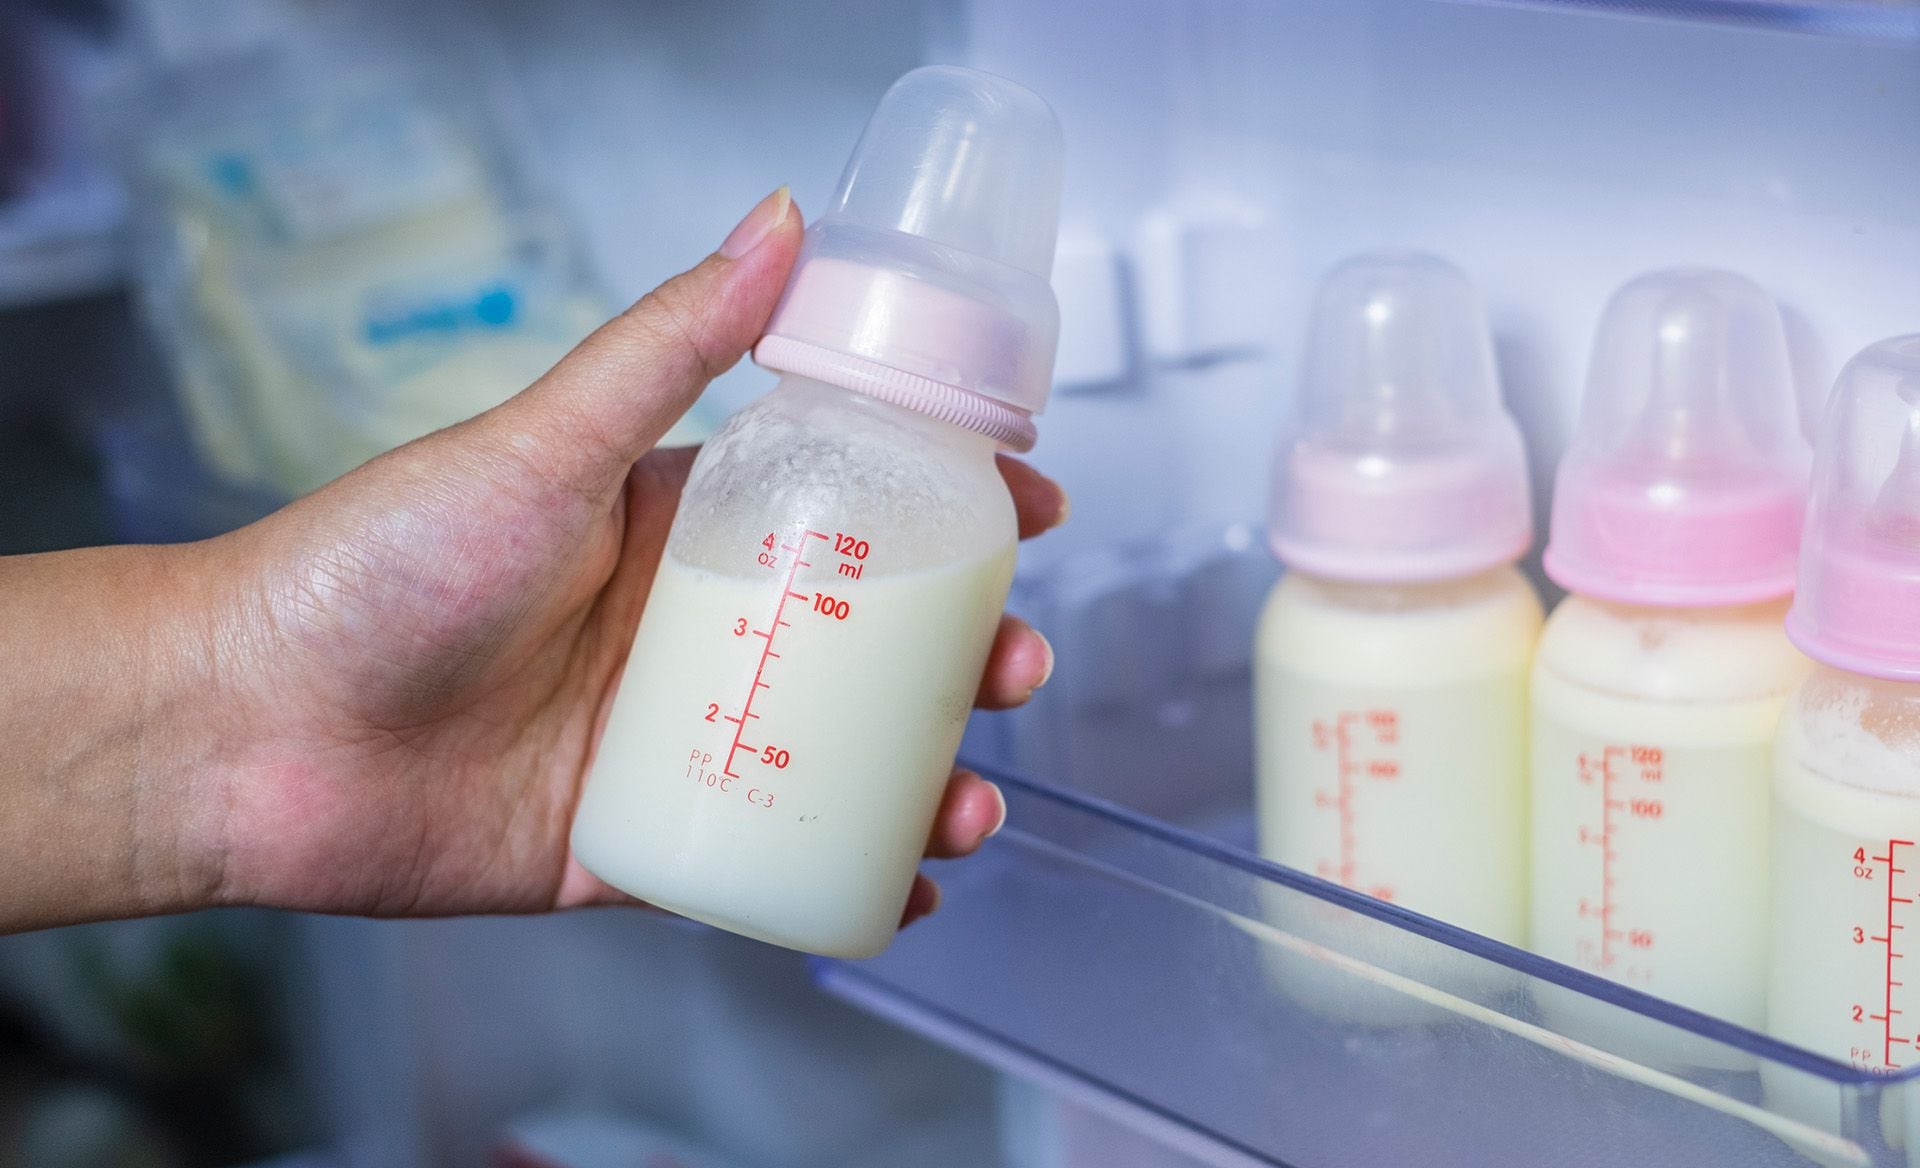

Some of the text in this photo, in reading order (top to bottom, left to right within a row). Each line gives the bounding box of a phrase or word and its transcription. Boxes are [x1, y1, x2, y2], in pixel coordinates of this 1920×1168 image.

[762, 532, 775, 551] 4
[834, 532, 870, 561] 120
[838, 562, 864, 580] ml
[813, 592, 850, 621] 100
[733, 618, 748, 637] 3
[704, 703, 720, 723] 2
[760, 745, 790, 769] 50
[747, 788, 775, 809] C-3
[1853, 846, 1866, 865] 4
[1852, 926, 1865, 944] 3
[1852, 1005, 1864, 1023] 2
